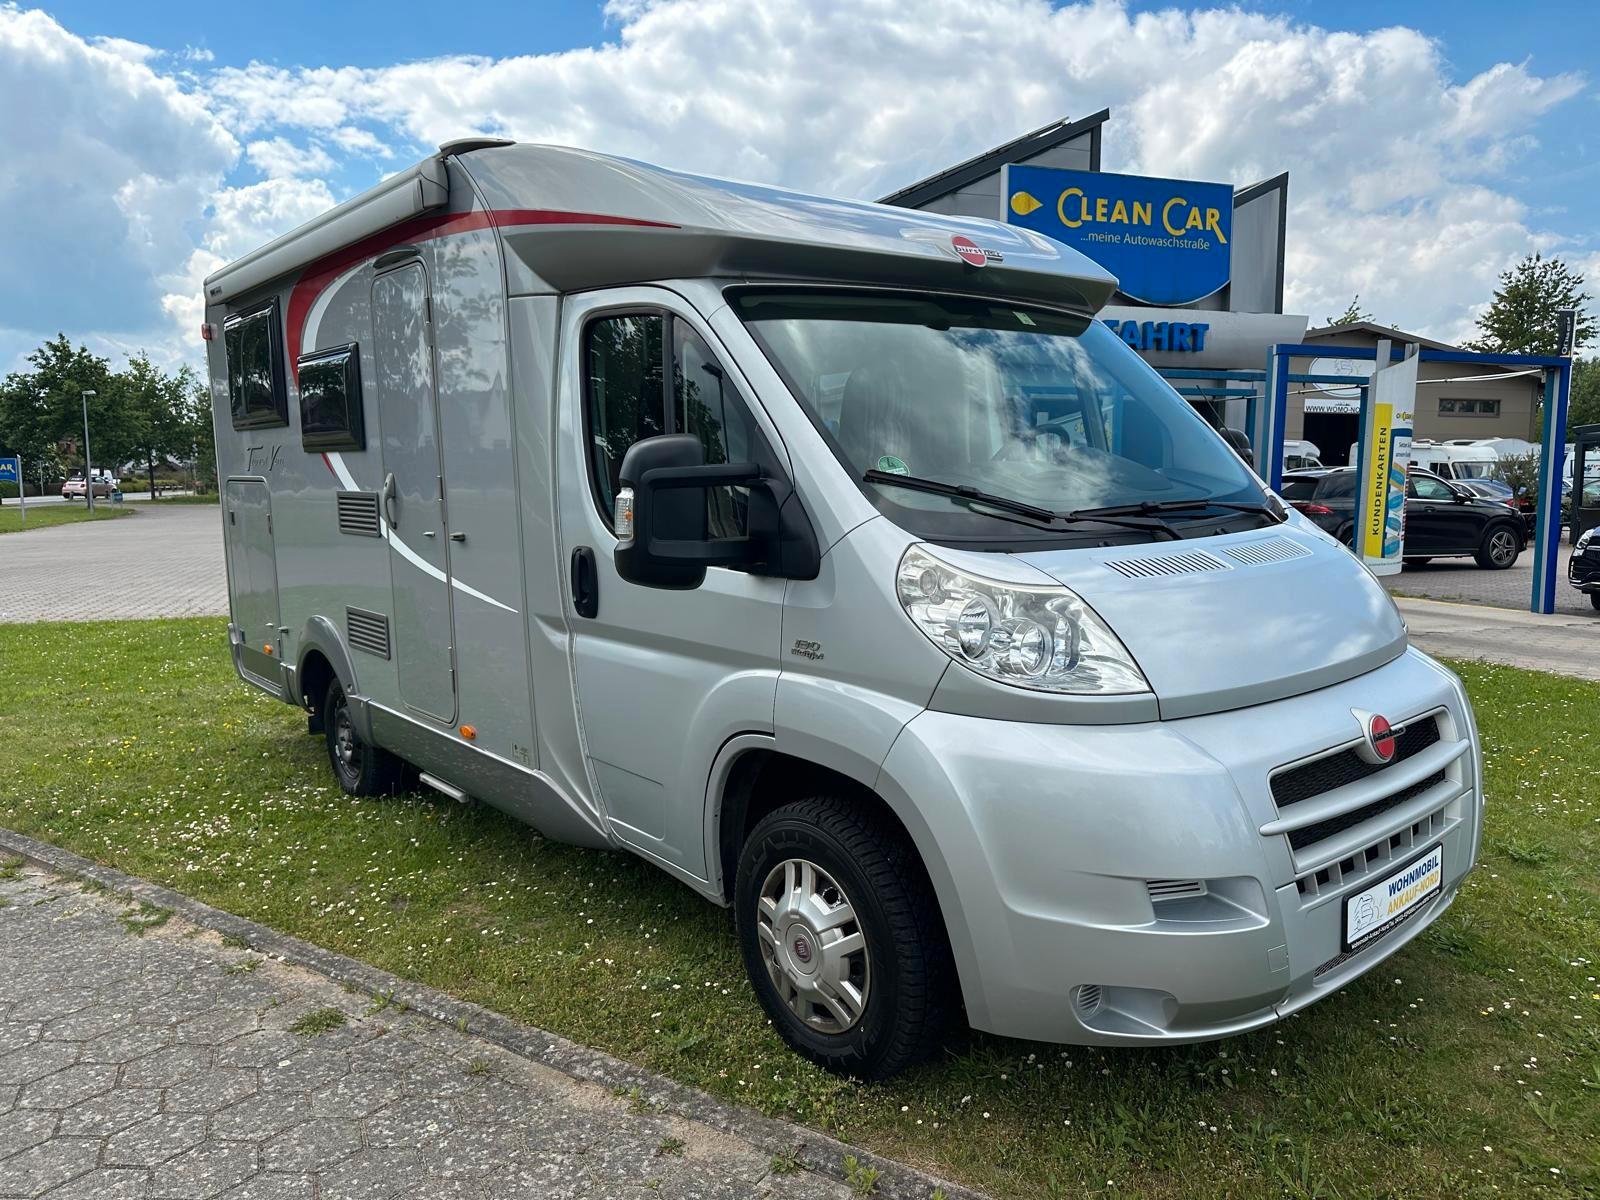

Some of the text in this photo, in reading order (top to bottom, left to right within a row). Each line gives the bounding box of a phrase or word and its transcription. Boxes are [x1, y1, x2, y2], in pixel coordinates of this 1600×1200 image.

[1057, 187, 1228, 244] CLEAN CAR
[1123, 233, 1210, 250] Autowaschstraße
[0, 463, 16, 474] AR
[1372, 426, 1387, 536] KUNDENKARTEN
[1387, 869, 1441, 915] ANKAUF-NORD
[1388, 855, 1439, 897] WOHNMOBIL
